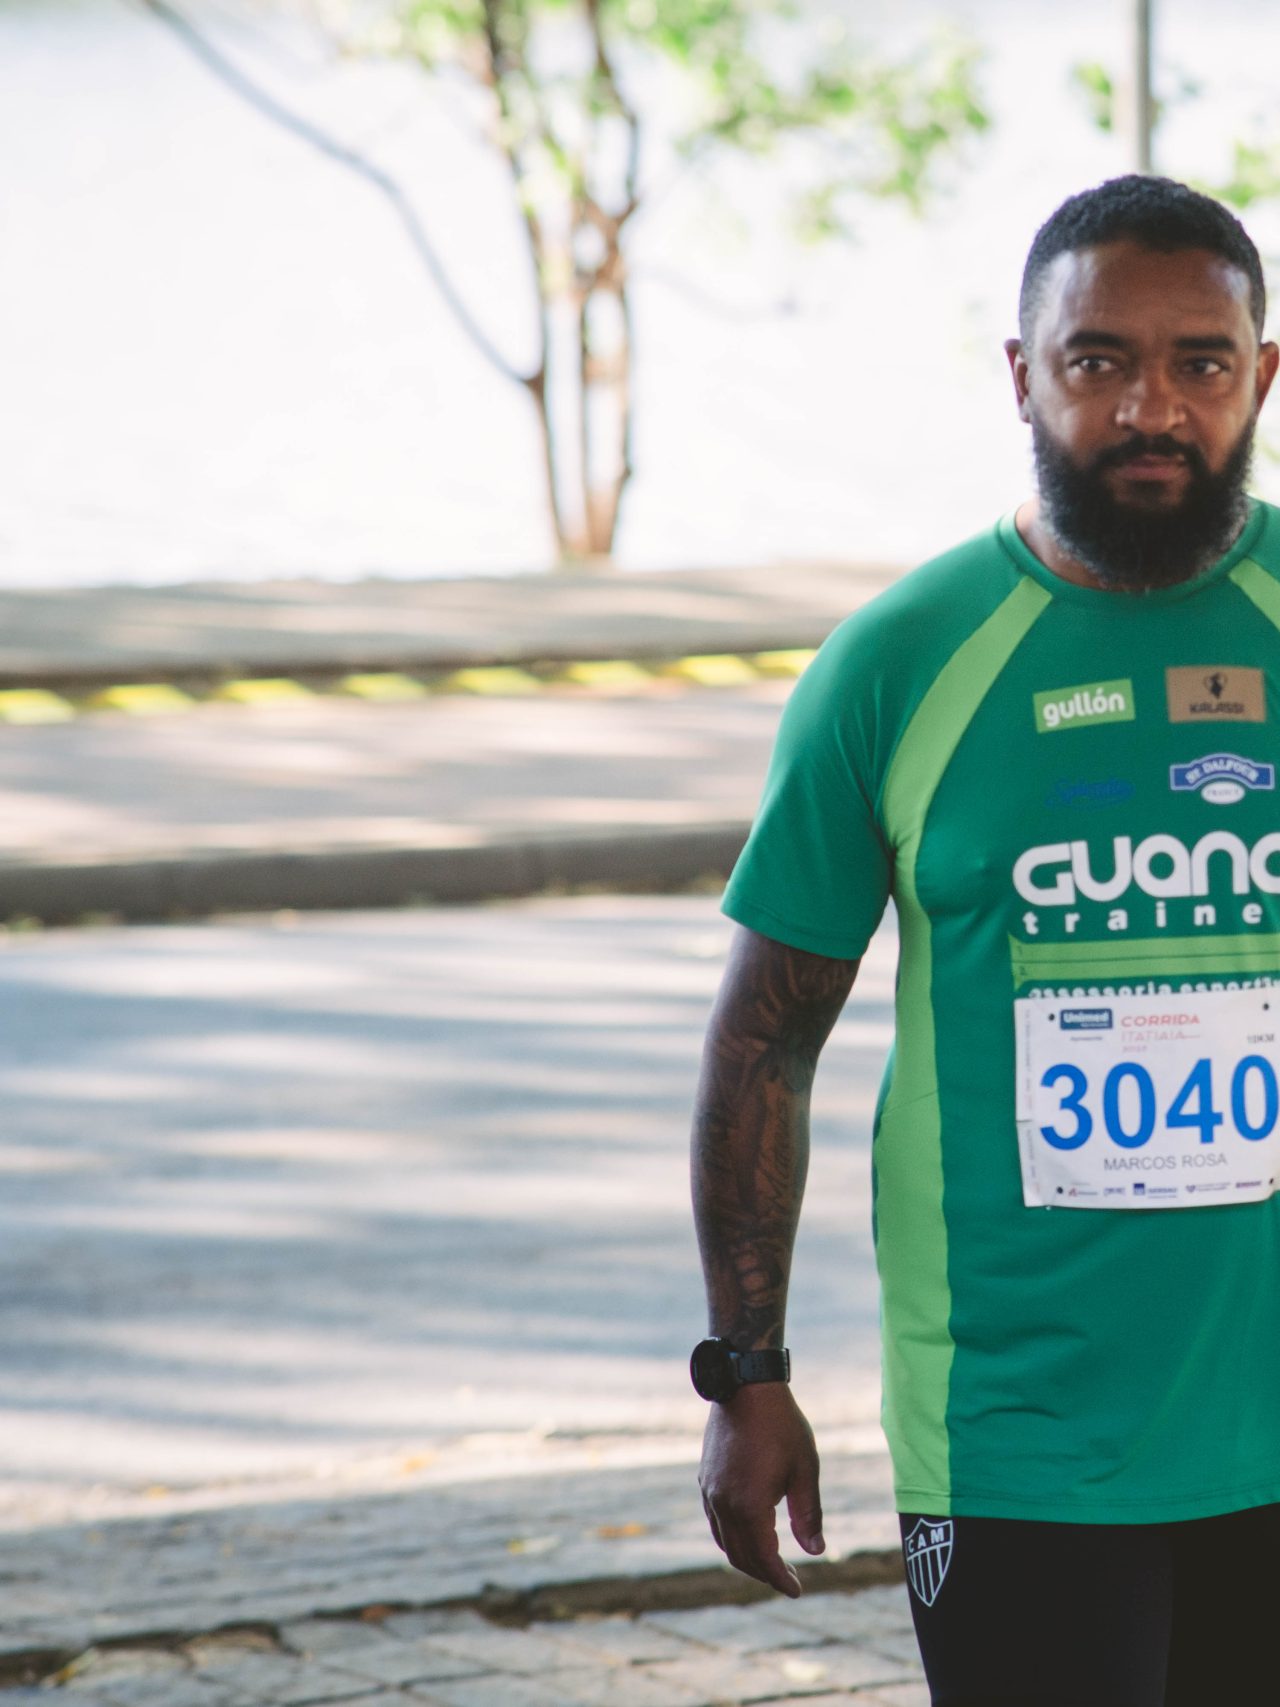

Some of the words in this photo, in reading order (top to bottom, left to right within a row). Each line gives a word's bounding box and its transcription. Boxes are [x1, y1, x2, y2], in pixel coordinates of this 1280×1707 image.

[1043, 687, 1125, 727] gullón
[1063, 1011, 1109, 1023] Unimed
[1121, 1014, 1200, 1028] CORRIDA
[1040, 1054, 1279, 1151] 3040
[1103, 1156, 1176, 1171] MARCOS
[1182, 1154, 1228, 1169] ROSA
